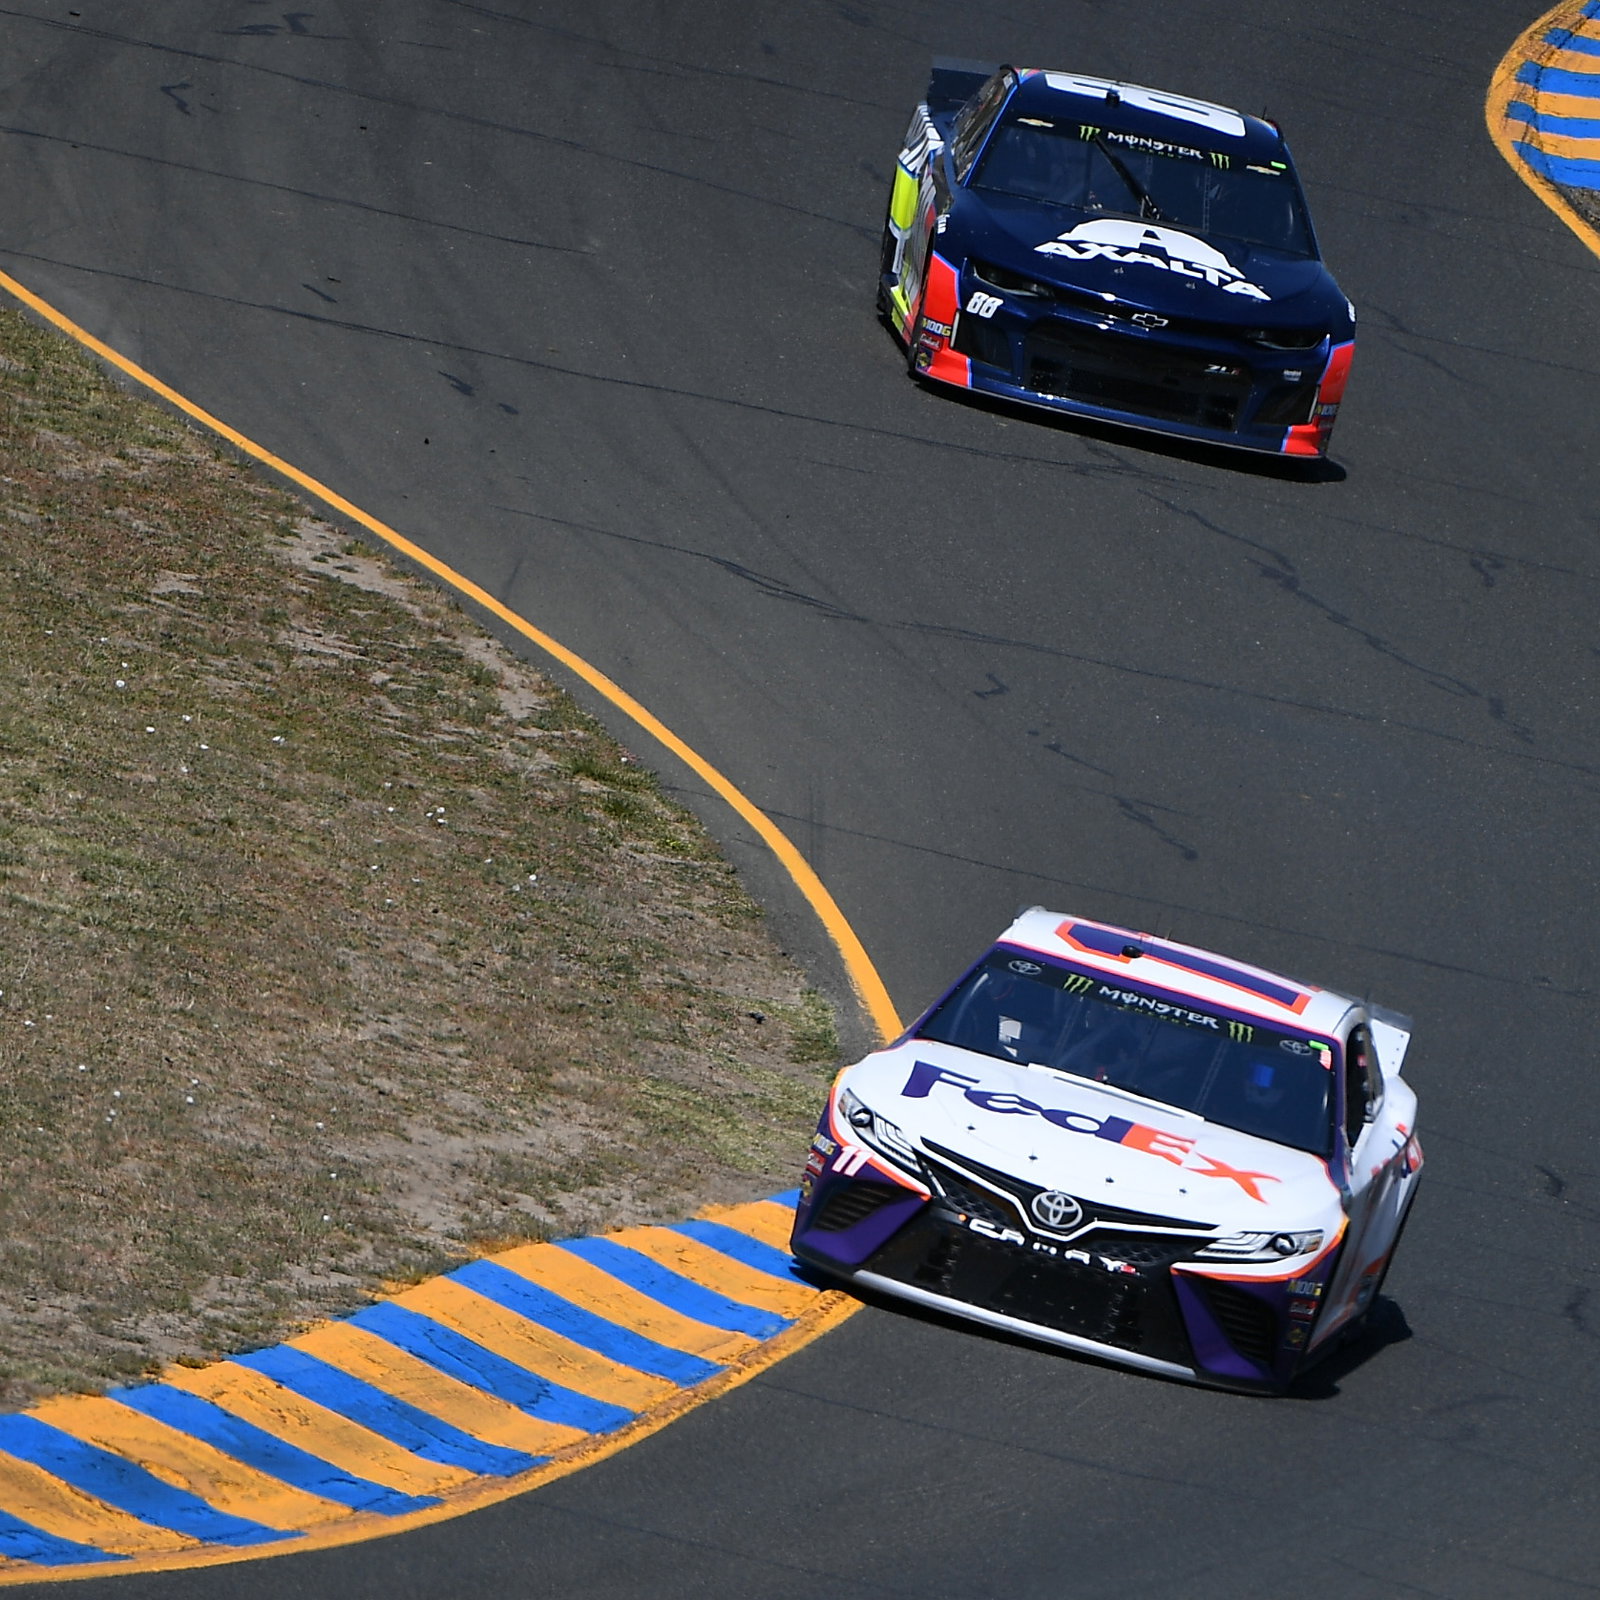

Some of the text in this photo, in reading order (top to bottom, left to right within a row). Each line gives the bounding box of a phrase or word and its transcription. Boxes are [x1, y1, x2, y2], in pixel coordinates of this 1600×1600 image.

[1107, 131, 1204, 159] MONSTER
[1034, 241, 1271, 301] AXALTA
[966, 291, 1004, 319] 88
[1099, 986, 1219, 1030] MONSTER
[901, 1060, 1282, 1205] FedEx
[831, 1145, 875, 1177] 11
